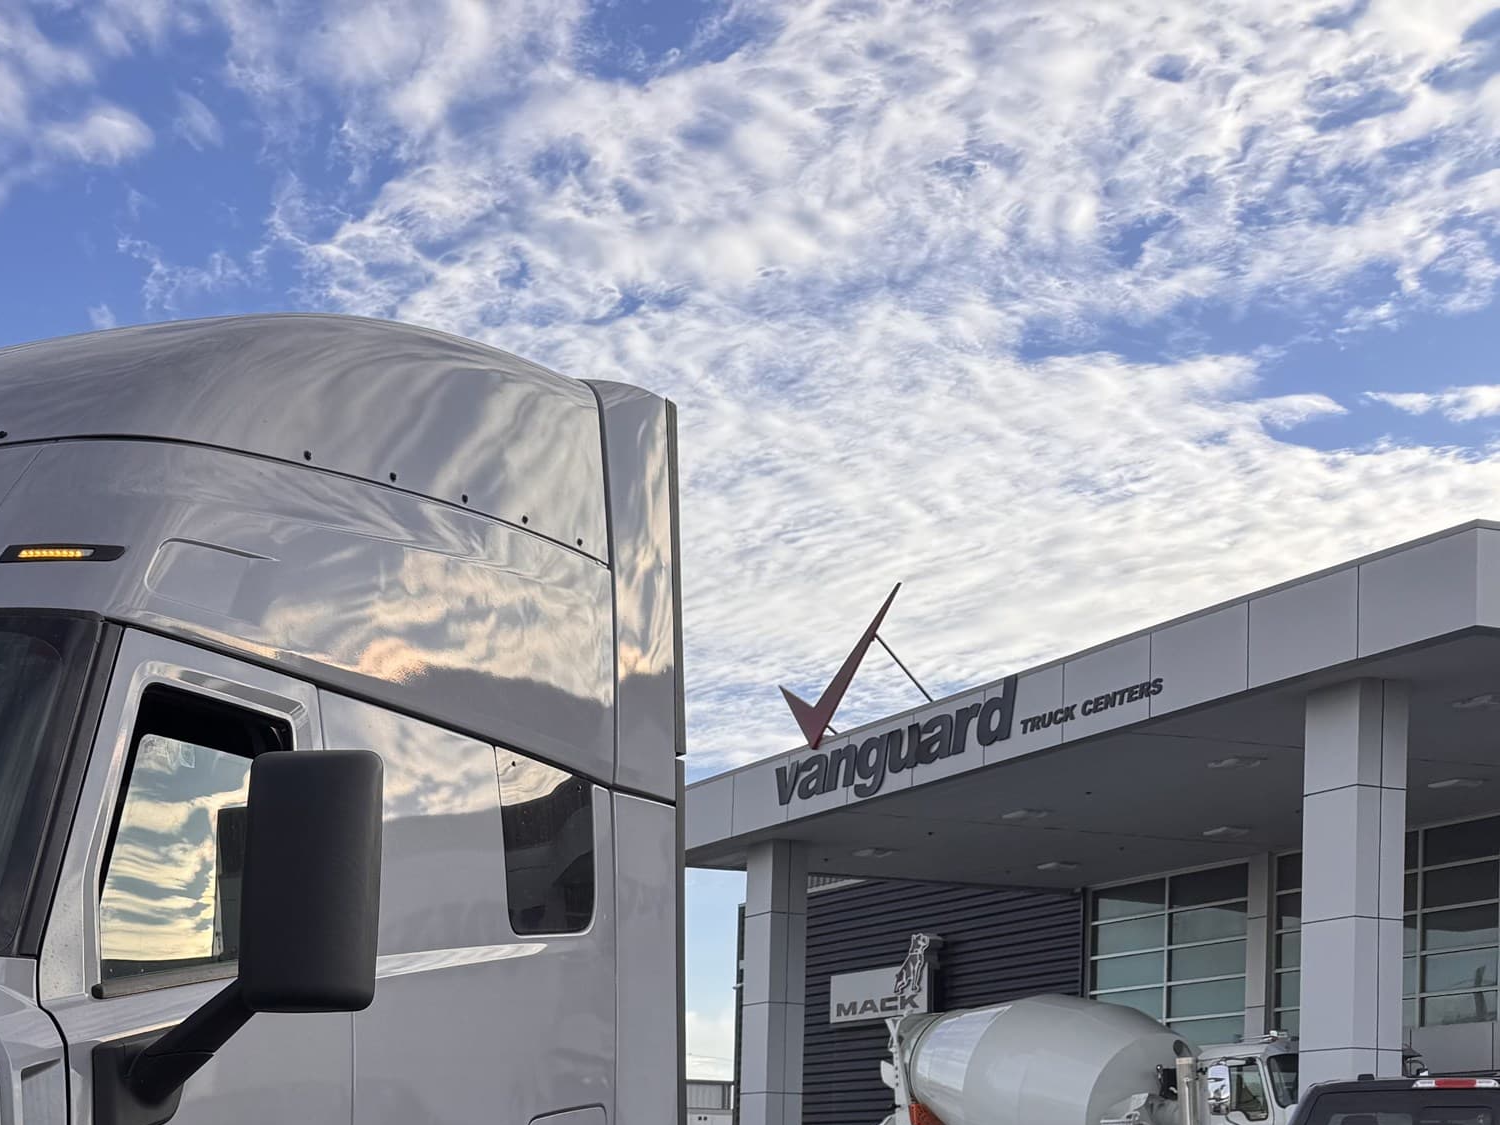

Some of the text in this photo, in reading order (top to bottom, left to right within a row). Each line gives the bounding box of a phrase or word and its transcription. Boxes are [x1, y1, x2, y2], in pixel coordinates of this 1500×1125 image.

[775, 674, 1164, 806] vanguard TRUCK CENTERS
[836, 994, 919, 1017] MACK
